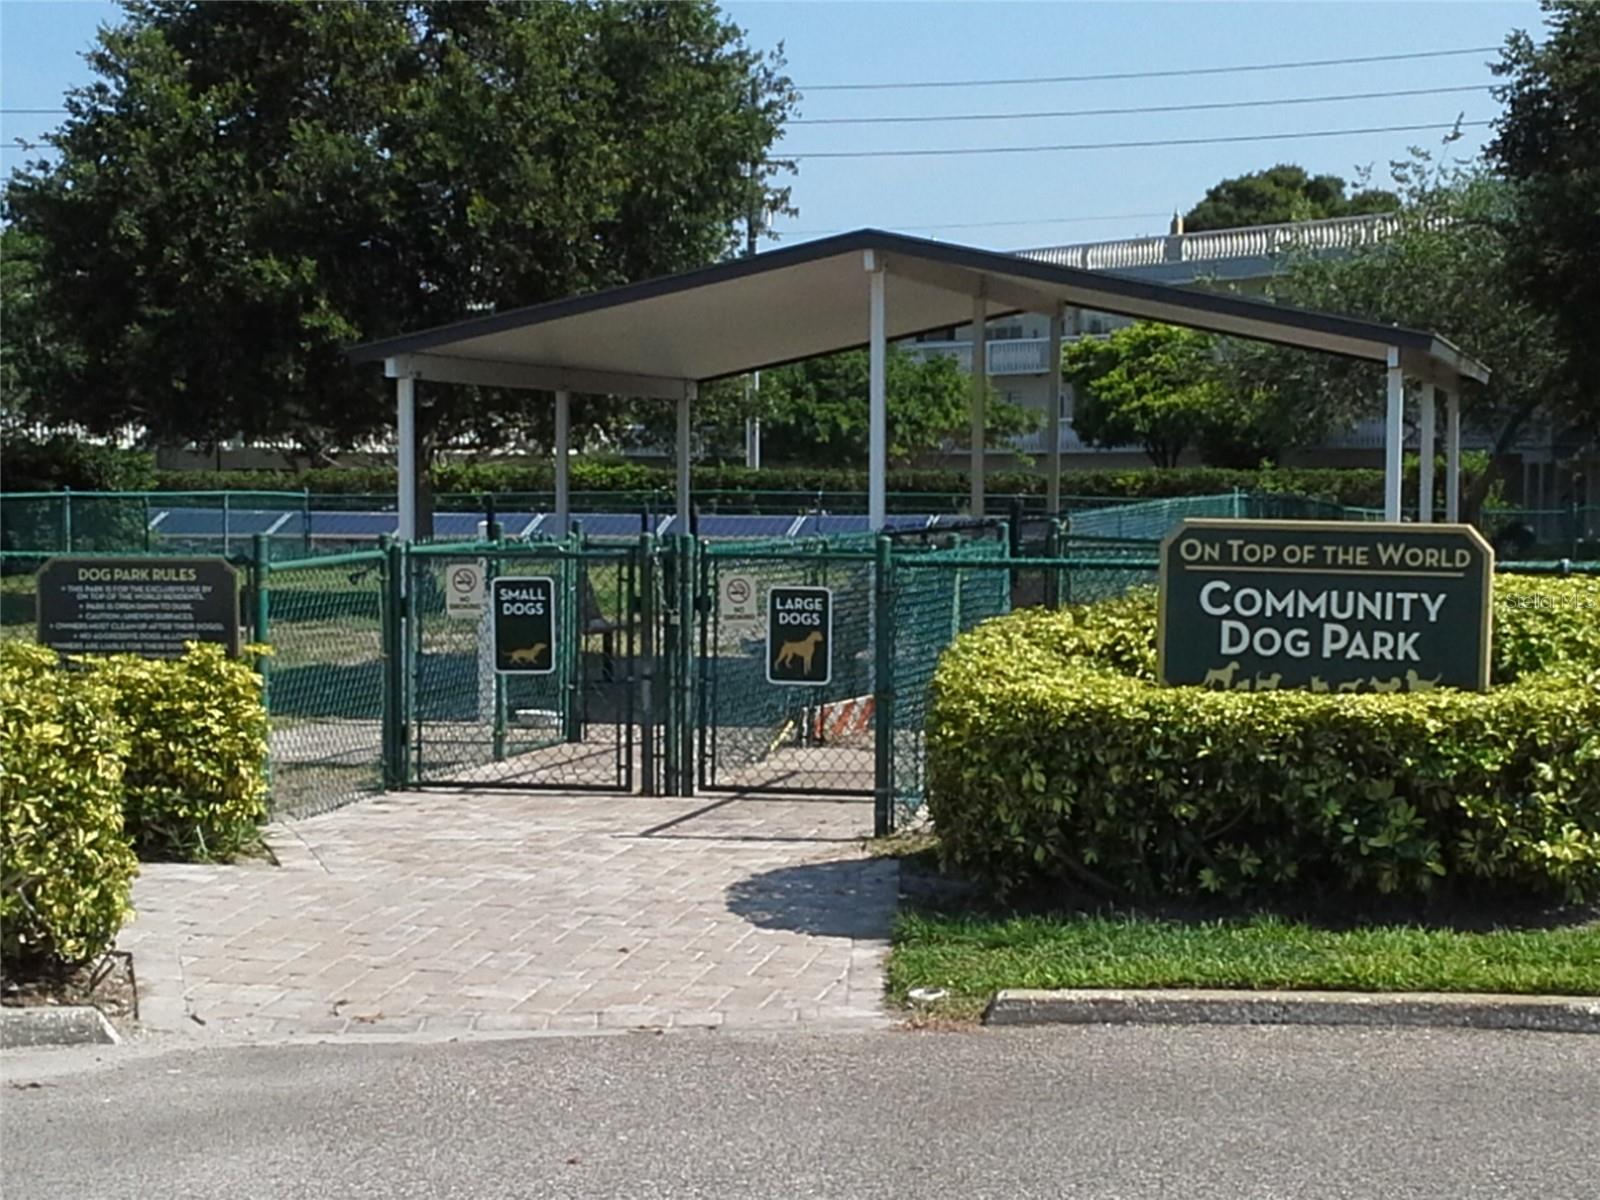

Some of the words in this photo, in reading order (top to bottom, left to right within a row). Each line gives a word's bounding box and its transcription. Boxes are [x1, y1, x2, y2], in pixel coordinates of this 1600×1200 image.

[1180, 538, 1220, 561] ON
[1226, 540, 1277, 563] TOP
[1282, 544, 1317, 564] OF
[1322, 545, 1370, 566] THE
[1376, 542, 1472, 568] WORLD
[78, 568, 111, 581] DOG
[113, 568, 150, 581] PARK
[152, 568, 197, 581] RULES
[500, 588, 546, 600] SMALL
[776, 597, 823, 611] LARGE
[1199, 580, 1447, 622] COMMUNITY
[503, 602, 544, 615] DOGS
[779, 612, 821, 625] DOGS
[1220, 620, 1310, 658] DOG
[1322, 622, 1421, 661] PARK
